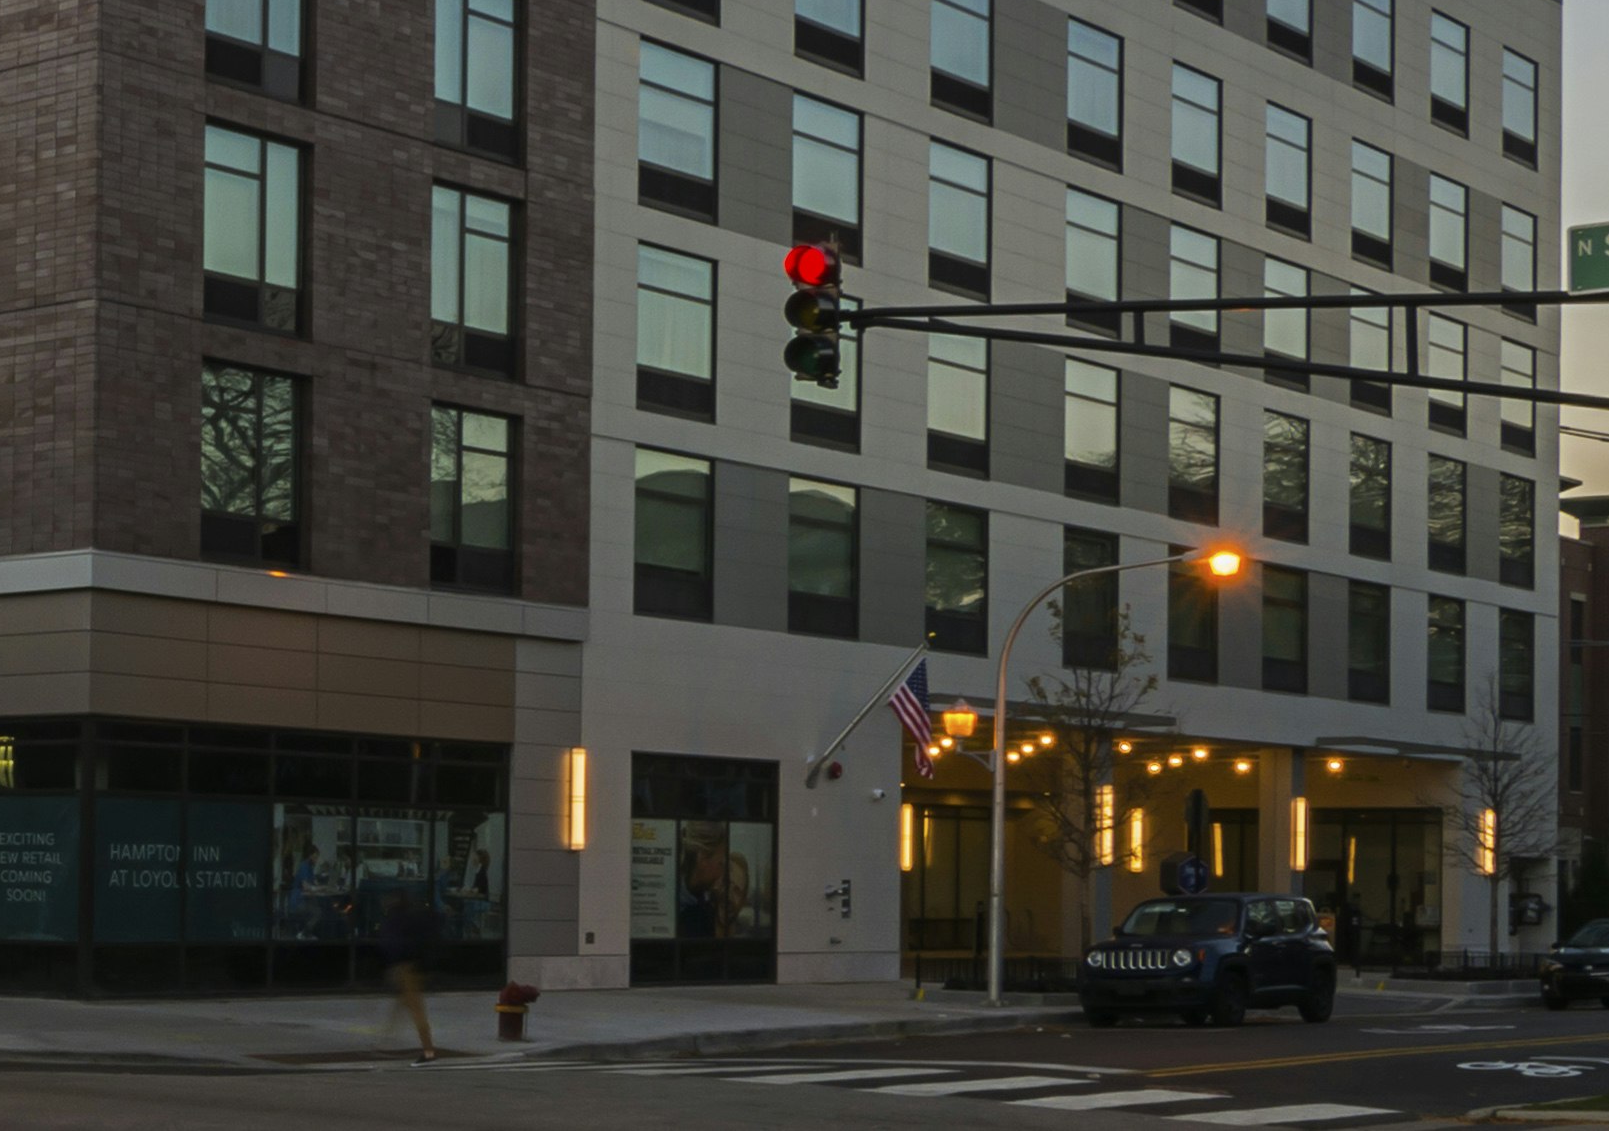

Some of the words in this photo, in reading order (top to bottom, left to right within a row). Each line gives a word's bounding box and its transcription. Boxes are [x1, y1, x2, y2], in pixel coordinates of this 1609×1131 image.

[1578, 239, 1592, 256] N
[22, 851, 63, 865] RETAIL
[193, 845, 220, 862] INN
[0, 870, 52, 884] COMING
[108, 869, 129, 887] AT
[196, 871, 257, 889] STATION
[6, 888, 47, 902] SOON!
